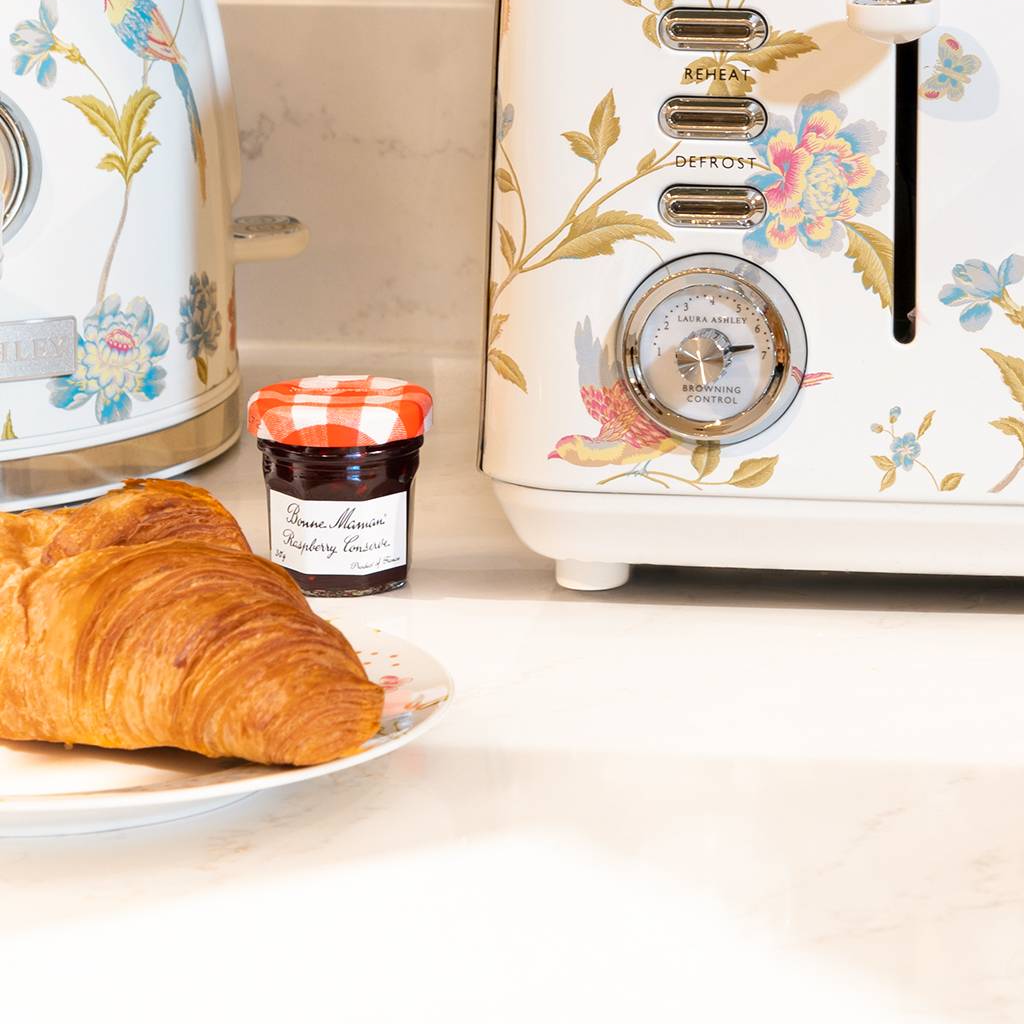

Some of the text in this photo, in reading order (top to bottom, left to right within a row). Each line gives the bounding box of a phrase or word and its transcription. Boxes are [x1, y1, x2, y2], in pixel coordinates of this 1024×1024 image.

[684, 67, 750, 82] REHEAT
[675, 155, 757, 170] DEFROST
[677, 315, 748, 325] LAURA ASHLEY
[664, 321, 670, 330] 2
[684, 302, 689, 311] 3
[736, 304, 742, 313] 5
[754, 325, 761, 334] 6
[760, 350, 767, 360] 7
[682, 384, 741, 394] BROWNING
[687, 395, 738, 405] CONTROL
[286, 503, 386, 529] Bonne Maman
[282, 529, 391, 559] Raspberry Conserve
